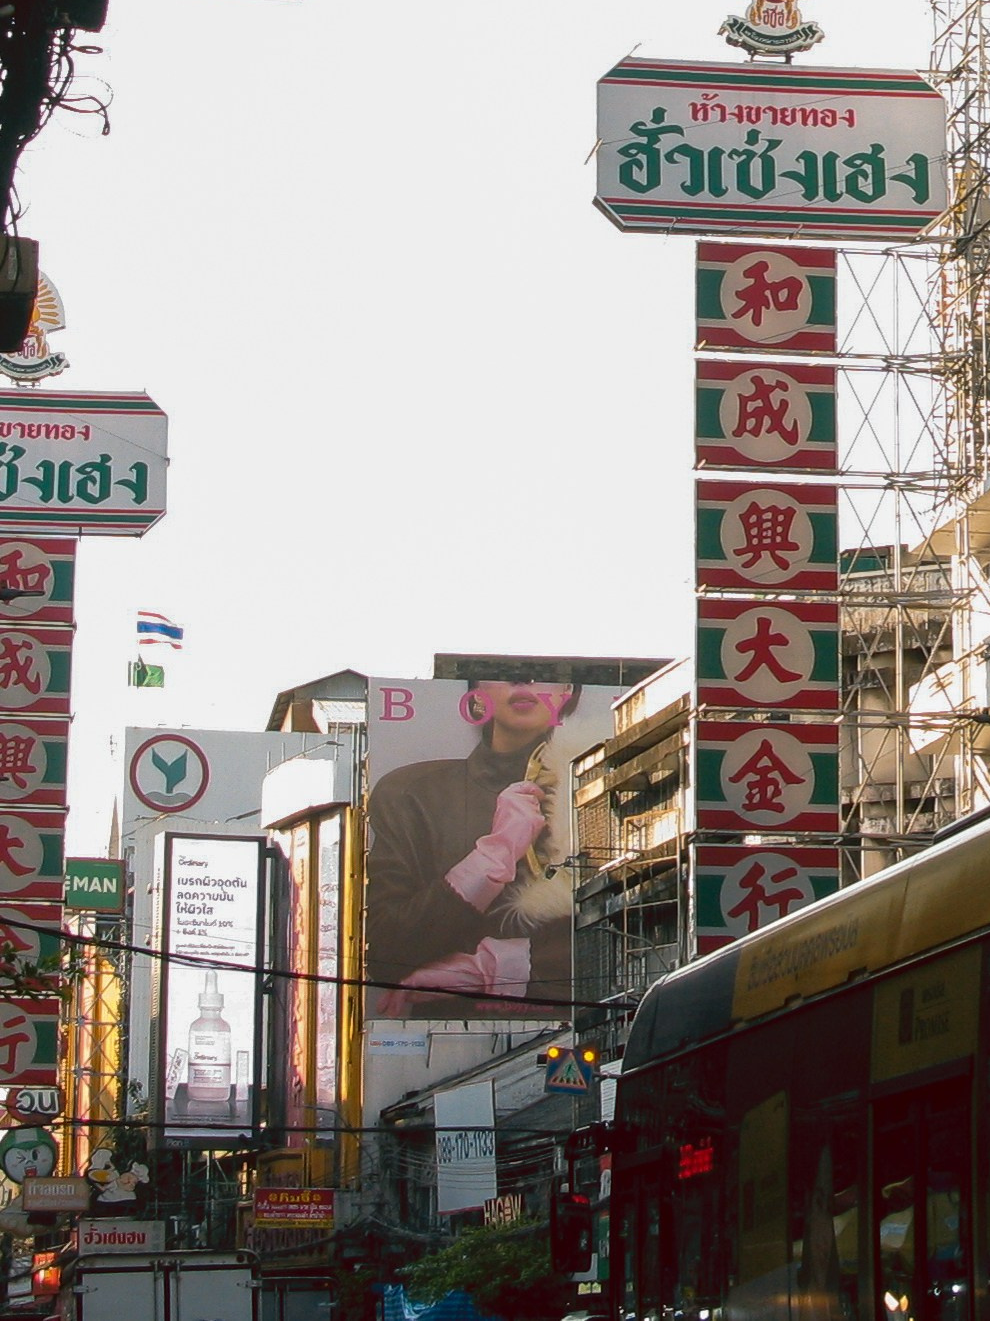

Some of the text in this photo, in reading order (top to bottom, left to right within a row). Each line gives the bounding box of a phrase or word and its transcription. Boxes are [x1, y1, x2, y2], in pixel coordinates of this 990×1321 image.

[688, 92, 856, 128] ห้างขายทอง
[617, 106, 932, 206] ฮั่วเซ่งเฮง
